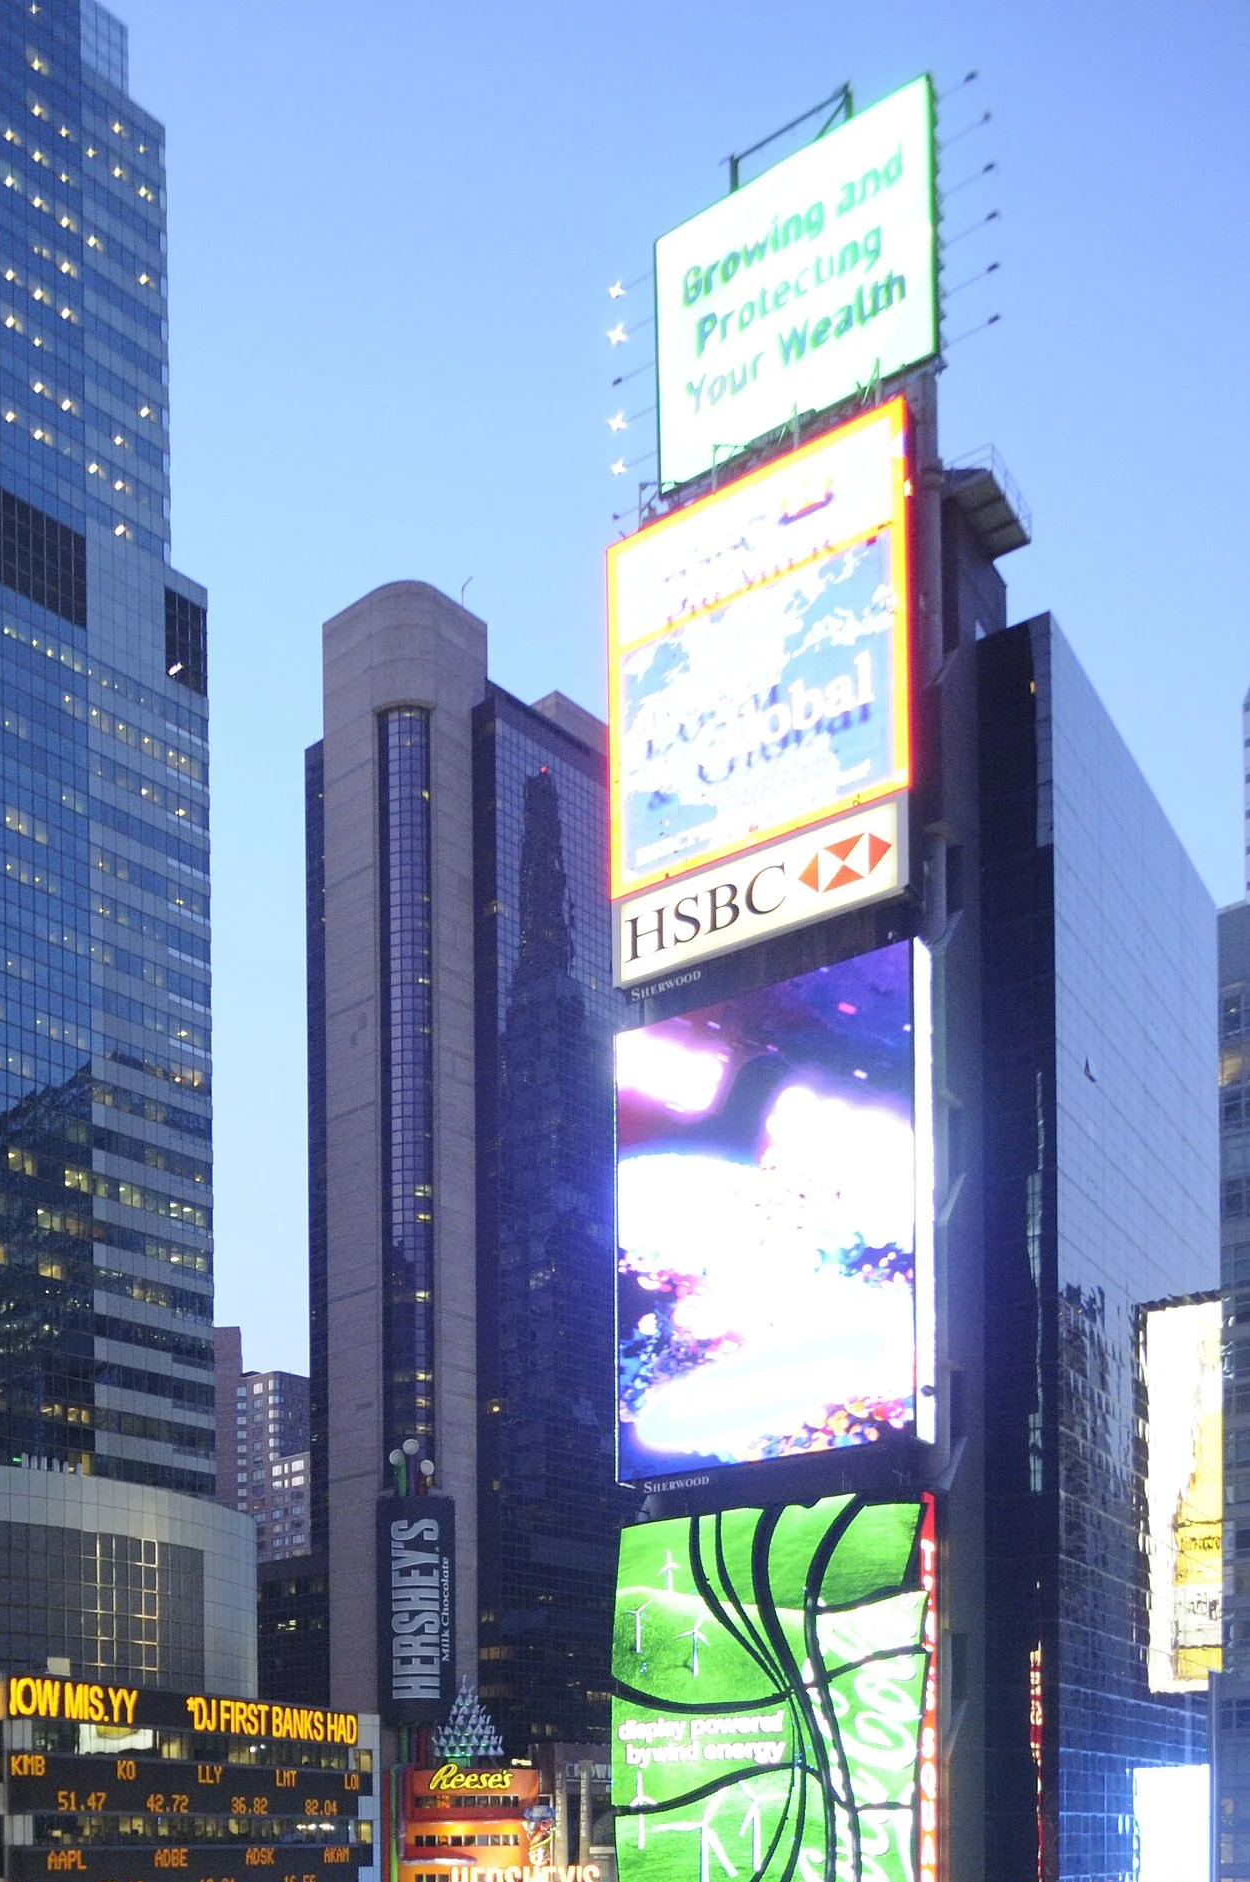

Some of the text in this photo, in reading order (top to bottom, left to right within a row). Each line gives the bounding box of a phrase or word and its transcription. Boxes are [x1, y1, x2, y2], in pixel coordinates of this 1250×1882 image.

[682, 140, 904, 307] Growing and
[696, 225, 882, 357] Protecting
[685, 270, 906, 413] Your Wealth
[624, 862, 787, 965] HSBC
[631, 969, 702, 1002] SHERWOOD
[643, 1475, 710, 1495] SHERWOOD
[392, 1517, 440, 1700] HERSHEY'S
[441, 1556, 451, 1663] Milk Chocolate
[64, 1681, 138, 1724] MIS.YY
[220, 1700, 269, 1736] FIRST
[272, 1706, 324, 1740] BANKS
[327, 1712, 358, 1744] HAD
[10, 1755, 46, 1776] KMB
[117, 1760, 136, 1780] KO
[197, 1765, 223, 1784] LLY
[275, 1769, 297, 1787] LMT
[429, 1763, 513, 1791] Reese's
[57, 1791, 107, 1812] 51.47
[146, 1794, 189, 1813] 42.72
[304, 1800, 338, 1816] 82.04
[47, 1847, 350, 1870] AAPL ADBE ADSK AKAM
